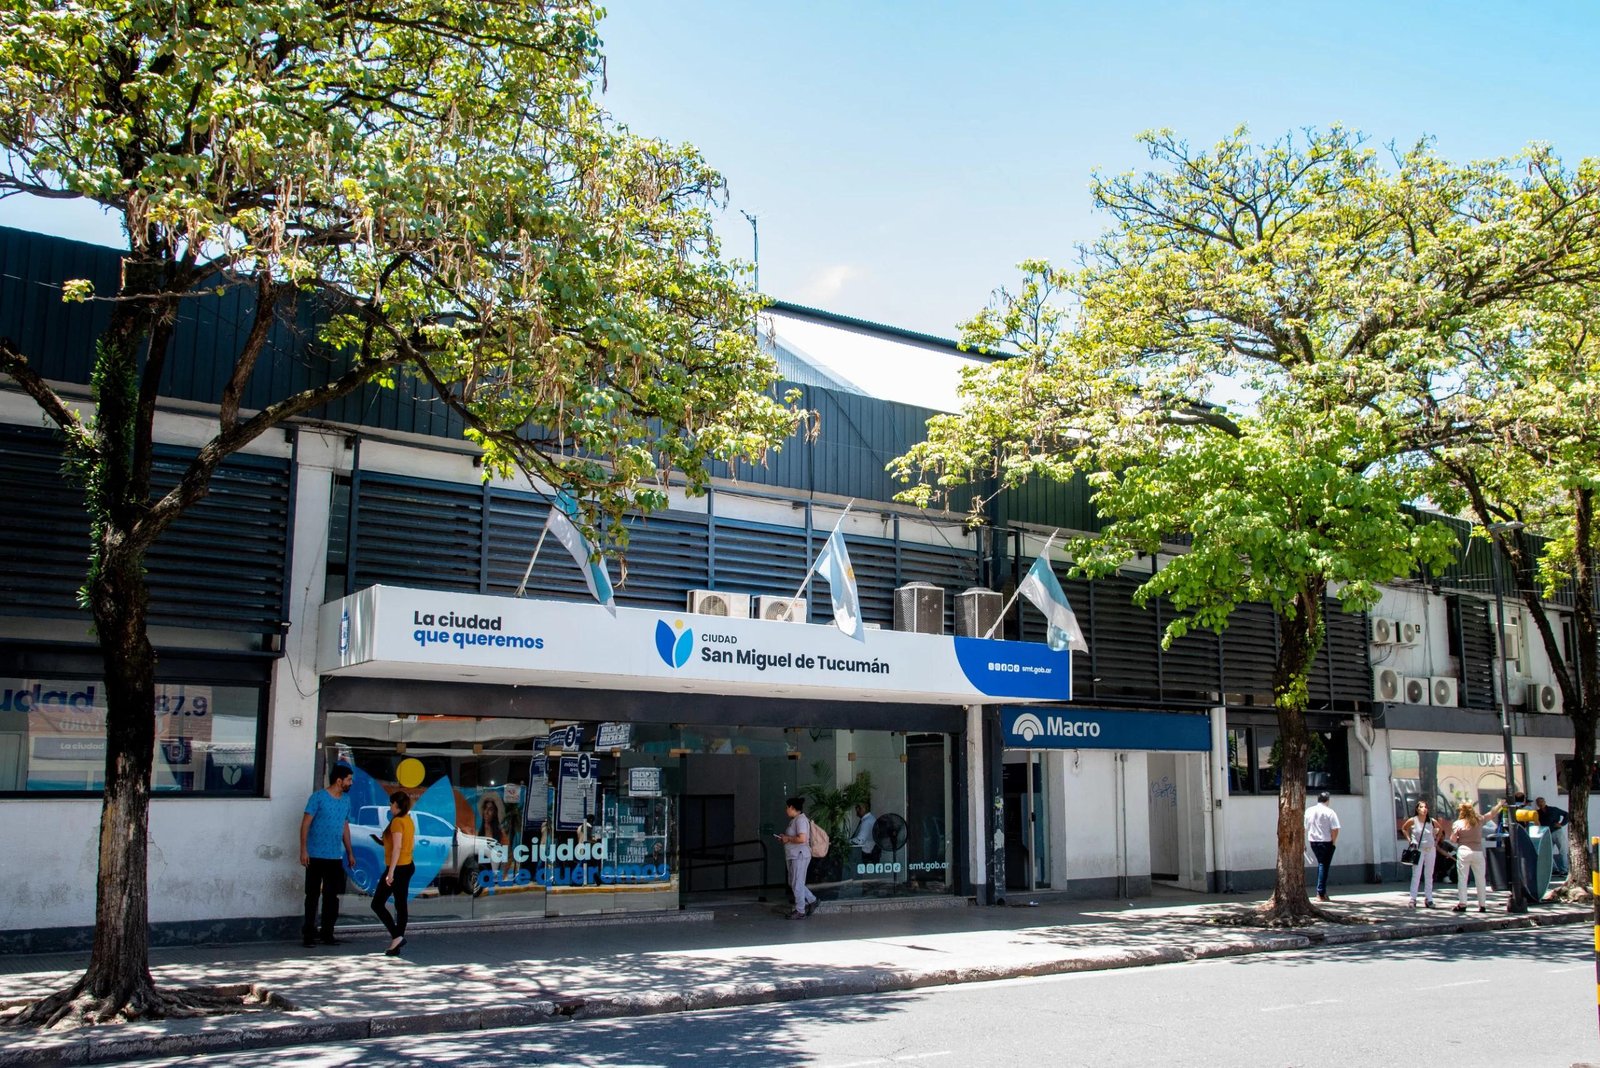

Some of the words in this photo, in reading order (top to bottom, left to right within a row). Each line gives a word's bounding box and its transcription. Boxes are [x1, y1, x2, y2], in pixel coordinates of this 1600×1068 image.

[414, 610, 435, 627] La
[438, 612, 502, 631] ciudad
[413, 629, 449, 647] que
[453, 631, 544, 649] queremos
[701, 634, 737, 645] CIUDAD
[701, 647, 733, 665] San
[736, 649, 792, 671] Miguel
[795, 651, 815, 668] de
[818, 656, 890, 675] Tucumán
[1021, 665, 1052, 675] smt.gob.ar
[1047, 716, 1101, 737] Macro
[478, 844, 508, 864] La
[513, 836, 609, 863] ciudad
[908, 860, 950, 872] smt.gob.ar
[478, 867, 532, 896] que
[535, 863, 671, 893] queremos
